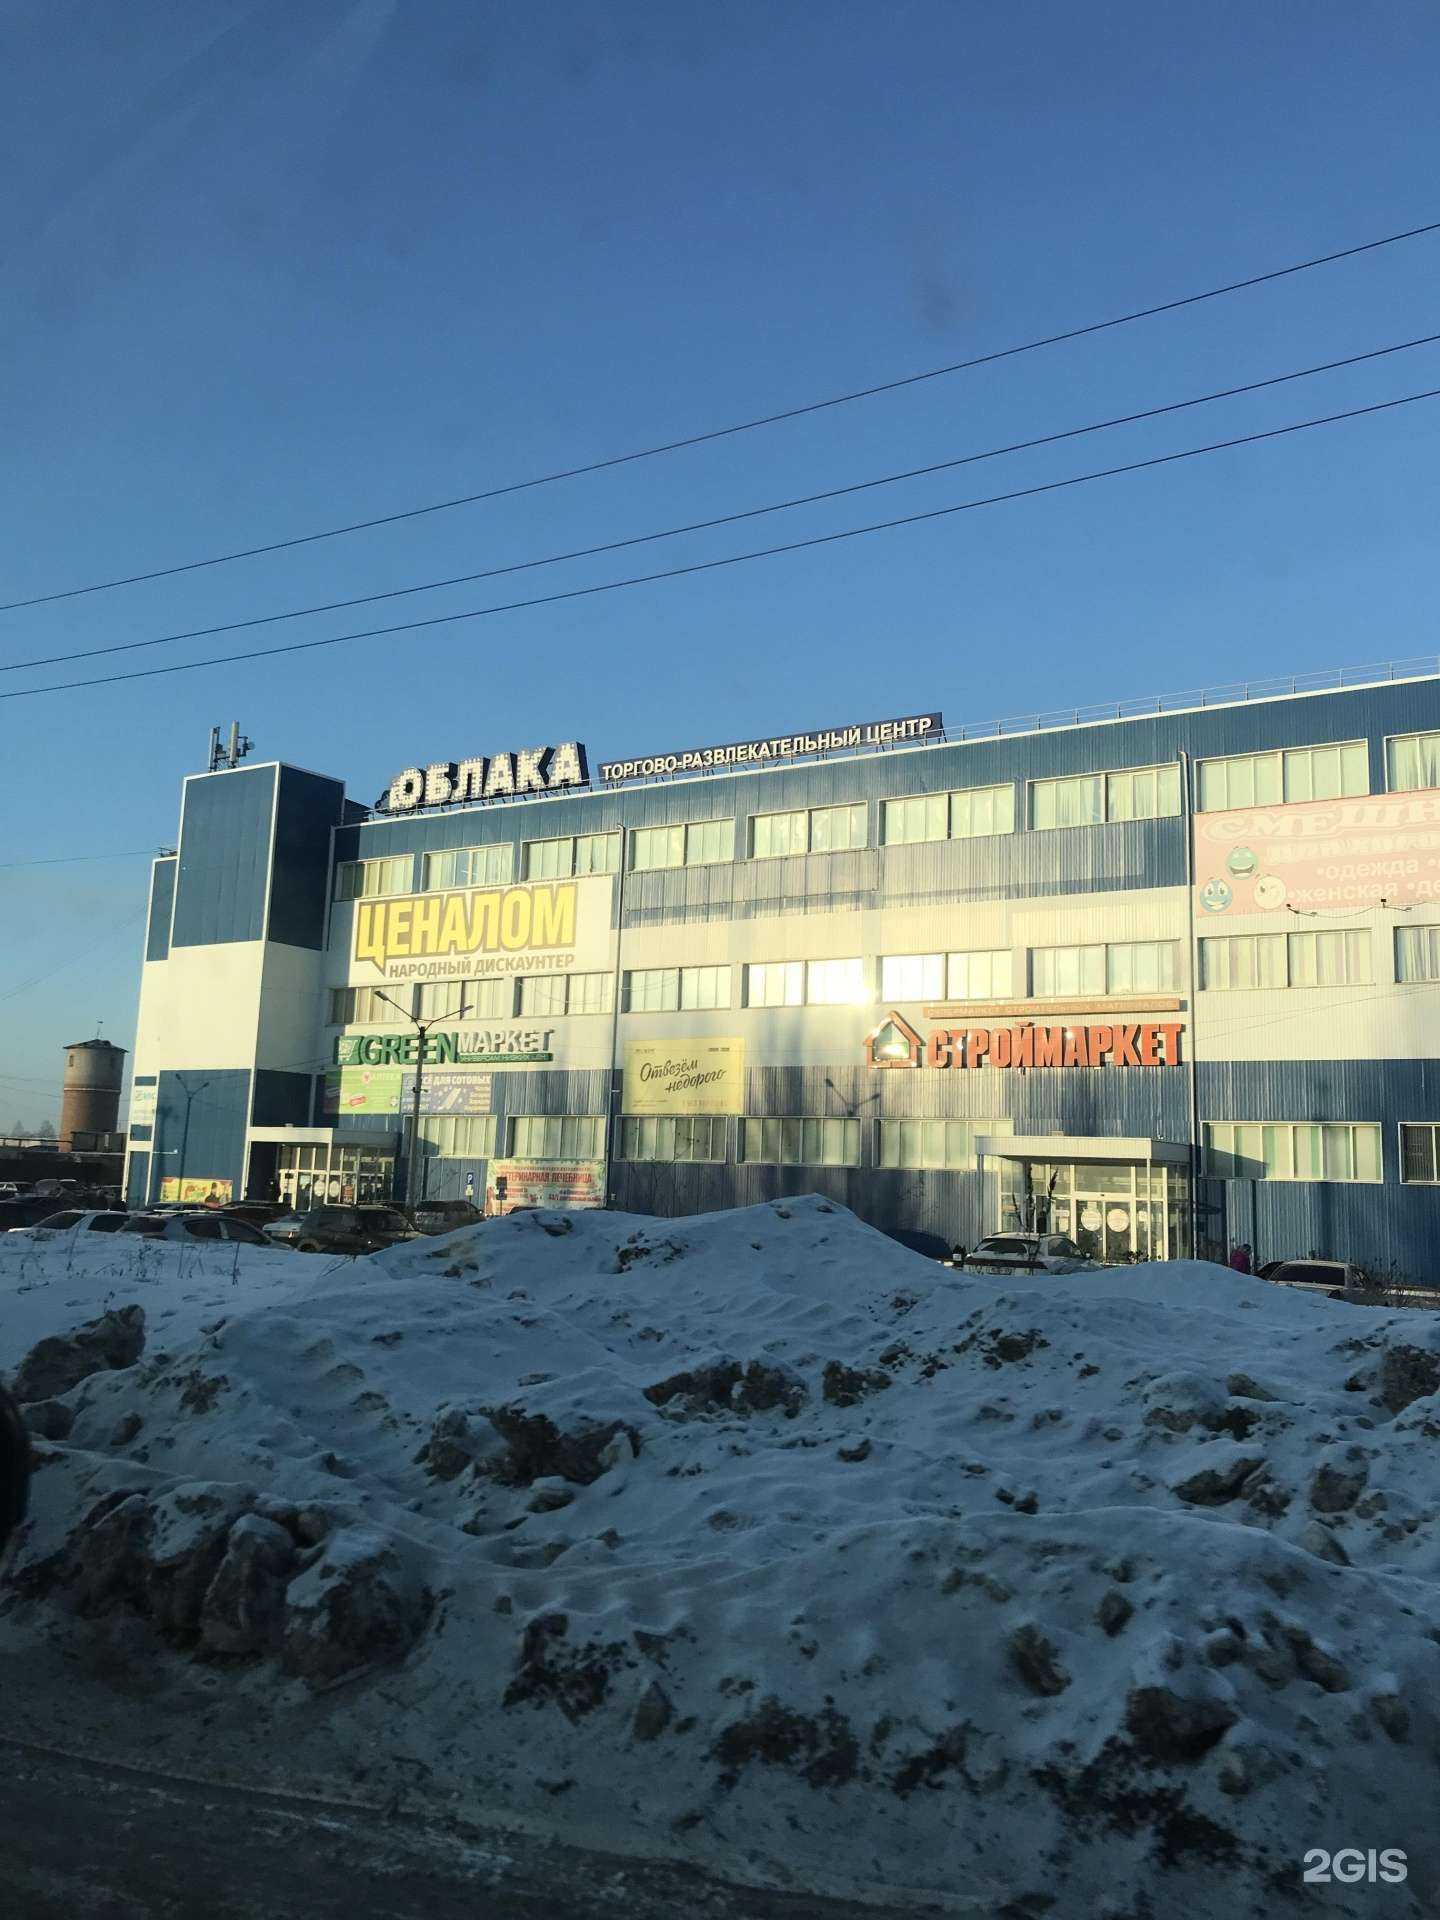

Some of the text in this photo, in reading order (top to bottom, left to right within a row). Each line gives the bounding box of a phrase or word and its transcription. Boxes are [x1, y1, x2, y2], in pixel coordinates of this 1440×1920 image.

[602, 717, 932, 780] ТОРГОВО-РАЗВЛЕКАТЕЛЬНЫЙ ЦЕНТР
[388, 741, 588, 812] ОБЛАКА
[355, 881, 578, 976] ЦЕНАЛОМ
[389, 953, 576, 978] НАРОДНЫЙ ДИСКАУНТЕР
[360, 1031, 459, 1066] GREEN
[927, 1021, 1183, 1068] СТРОЙМАРКЕТ
[640, 1058, 698, 1082] Отвезём
[665, 1069, 727, 1094] недорого
